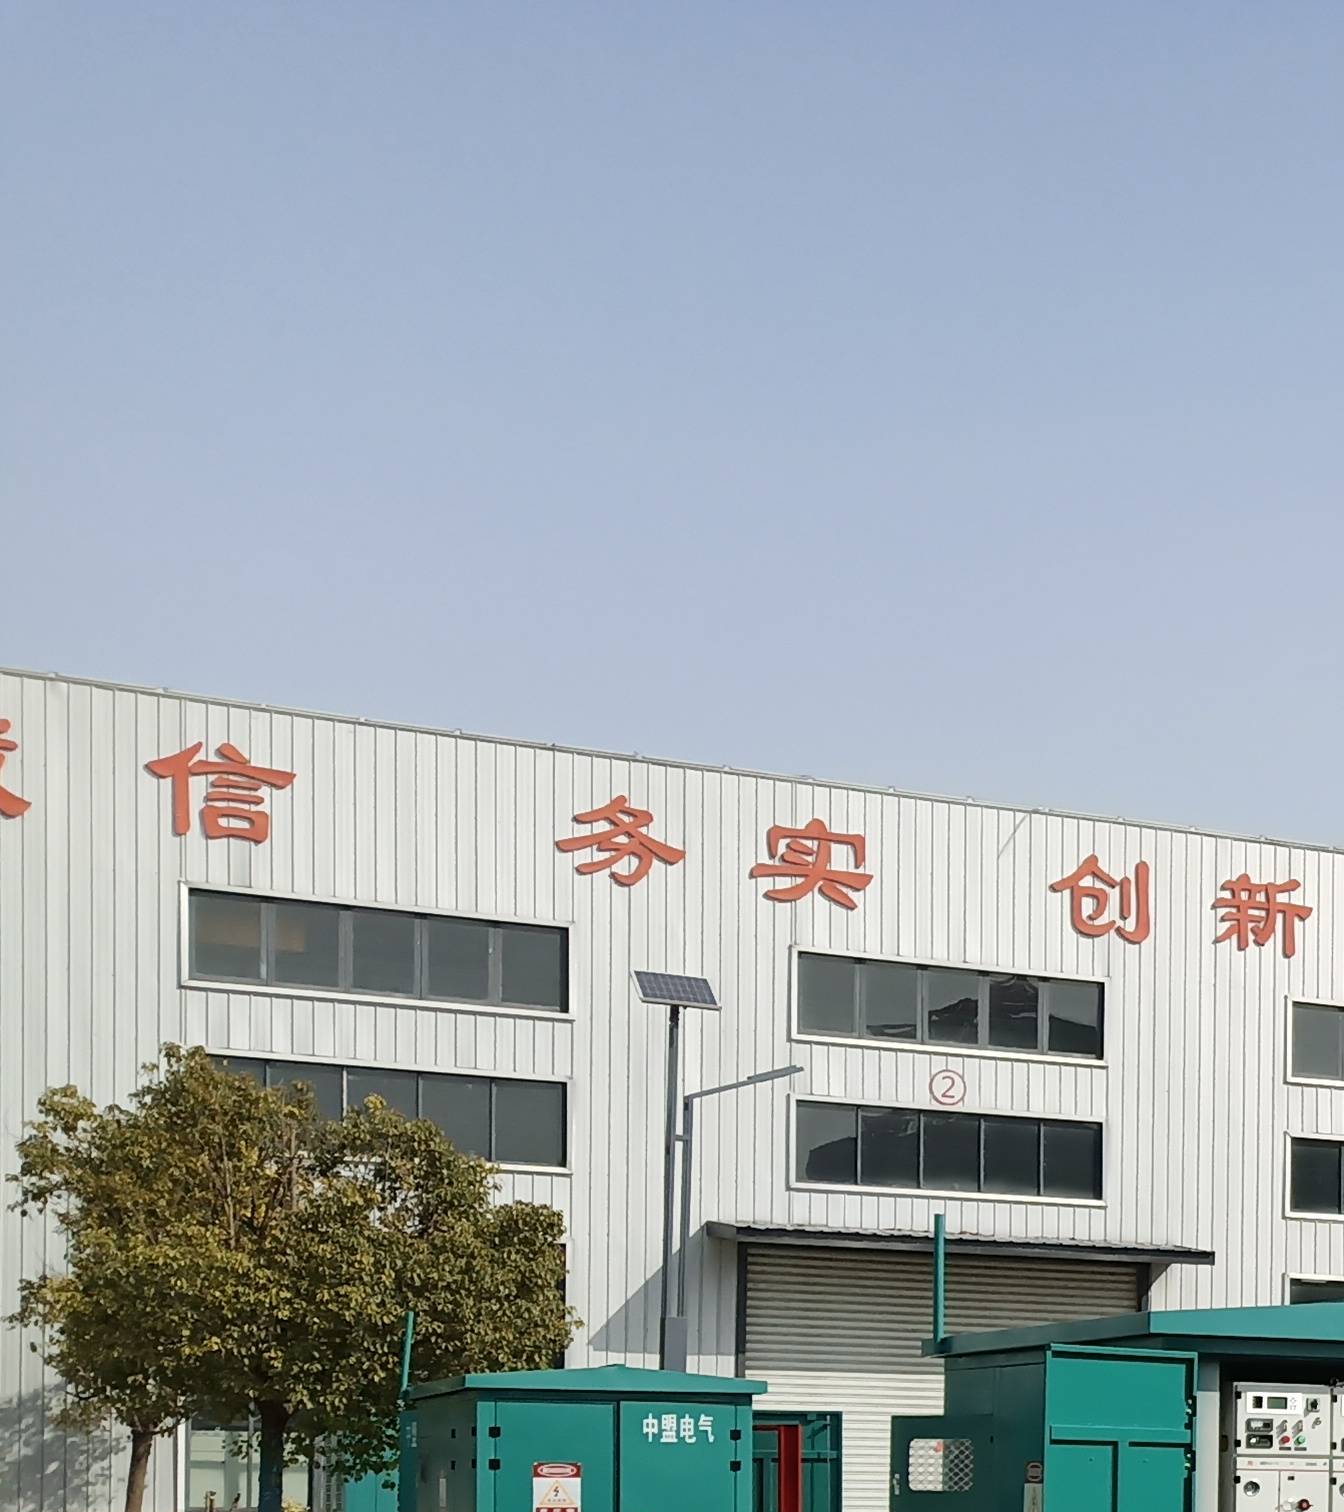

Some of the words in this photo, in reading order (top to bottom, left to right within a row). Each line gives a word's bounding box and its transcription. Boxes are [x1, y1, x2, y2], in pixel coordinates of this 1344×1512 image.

[0, 719, 296, 843] 信
[558, 796, 873, 909] 务实
[1050, 855, 1312, 957] 创新
[642, 1412, 715, 1443] 中盟电气
